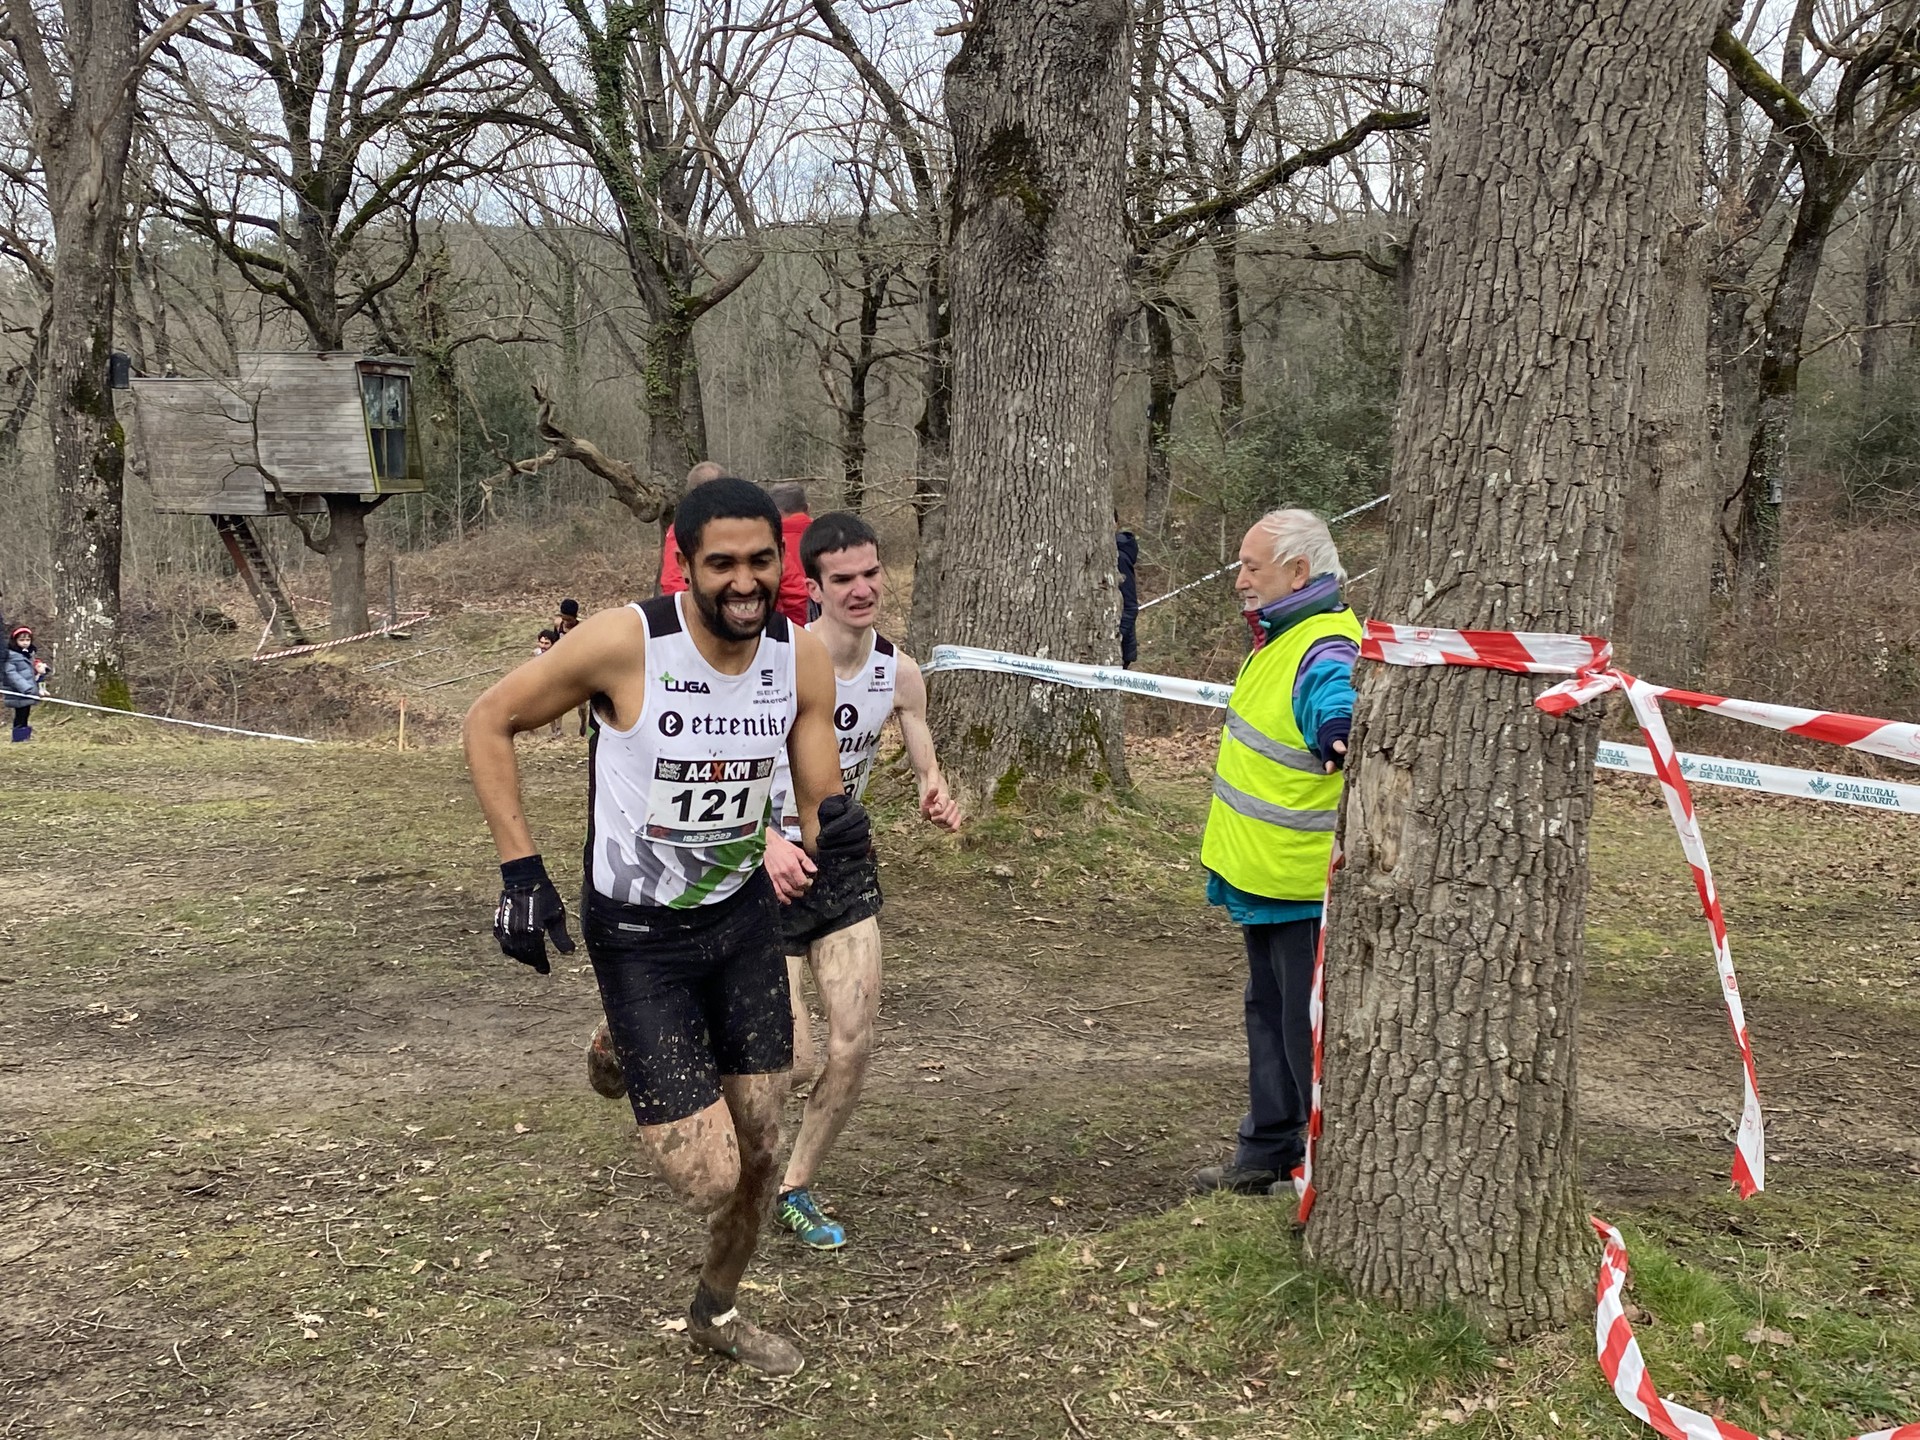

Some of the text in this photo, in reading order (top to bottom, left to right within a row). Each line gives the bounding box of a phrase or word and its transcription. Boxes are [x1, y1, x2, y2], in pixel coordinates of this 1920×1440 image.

[1700, 763, 1759, 778] CAJA RURAL
[1699, 771, 1762, 786] DE NAVARRA
[1835, 790, 1900, 806] DE NAVARRA
[1836, 783, 1897, 798] CAJA RURAL
[671, 787, 750, 822] 121
